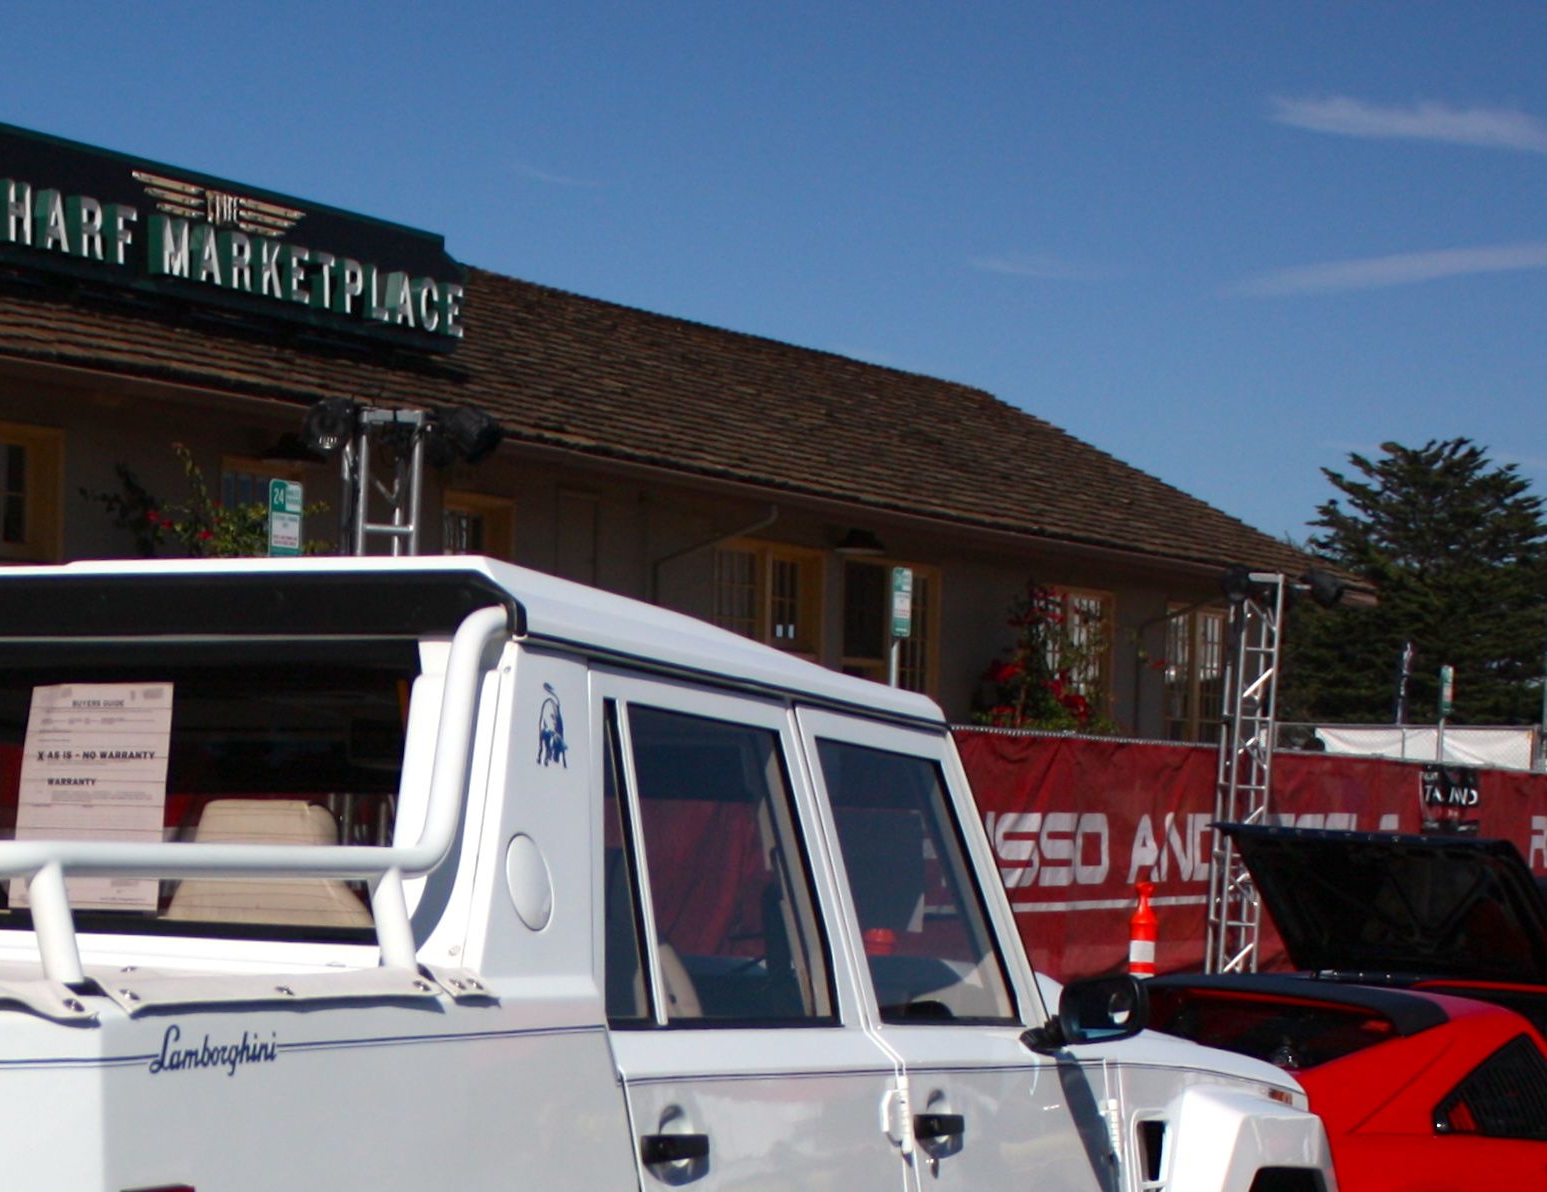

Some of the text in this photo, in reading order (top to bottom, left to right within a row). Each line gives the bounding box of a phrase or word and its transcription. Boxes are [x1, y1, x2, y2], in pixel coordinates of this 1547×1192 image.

[156, 216, 464, 338] MARKETPLACE
[273, 487, 285, 505] 24
[47, 750, 60, 760] AS
[62, 750, 73, 760] IS
[82, 750, 97, 760] NO
[99, 751, 156, 760] WARRANTY
[47, 777, 97, 787] WARRANTY
[986, 811, 1110, 888] SSO
[149, 1024, 277, 1077] Lamborghini
